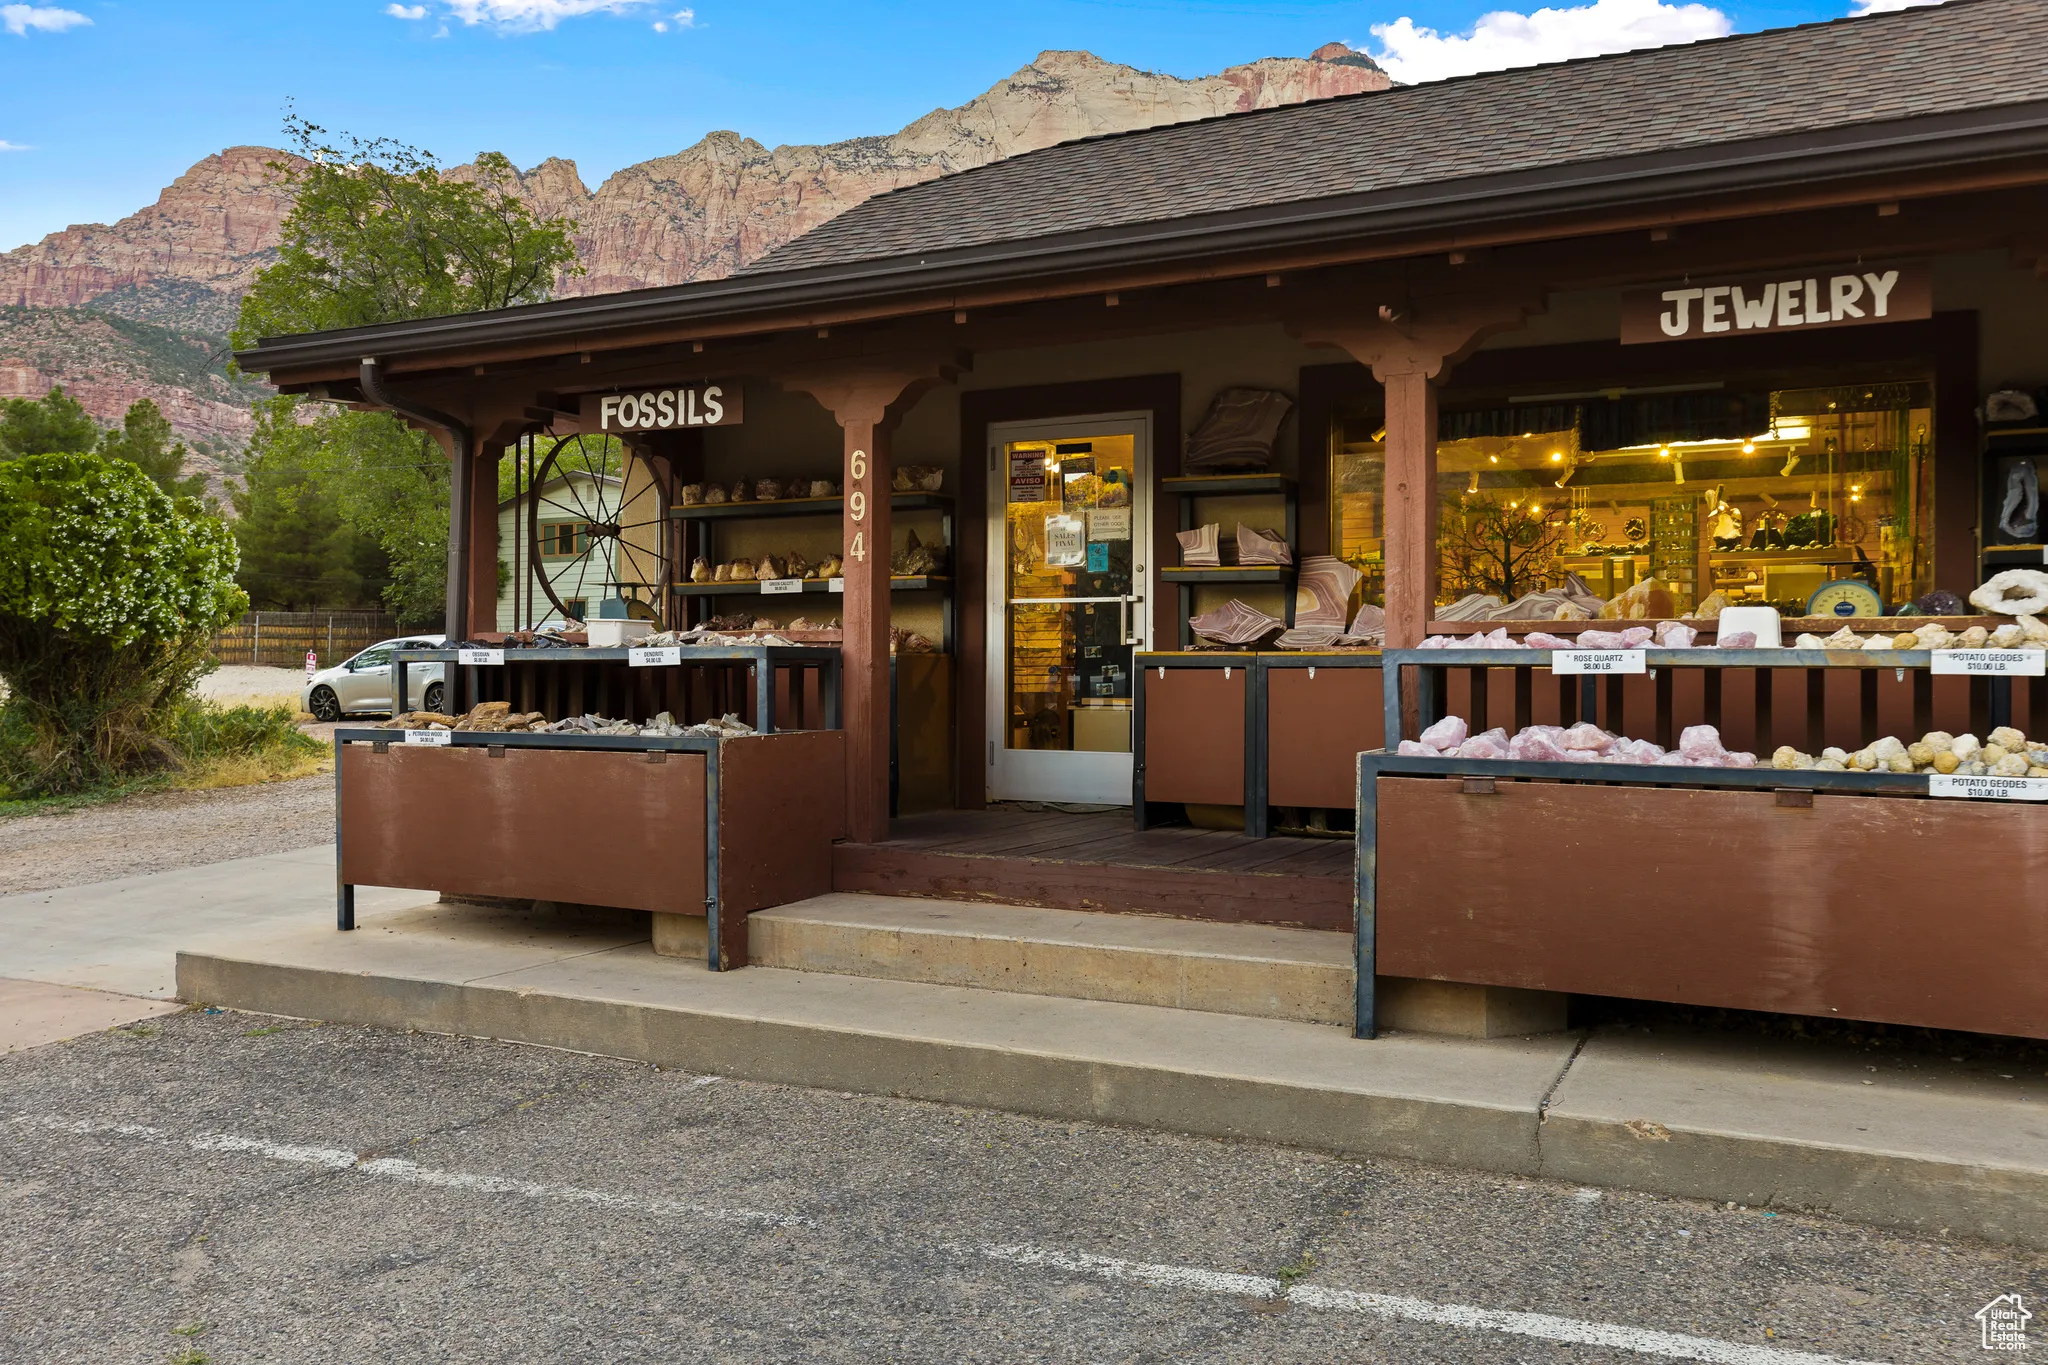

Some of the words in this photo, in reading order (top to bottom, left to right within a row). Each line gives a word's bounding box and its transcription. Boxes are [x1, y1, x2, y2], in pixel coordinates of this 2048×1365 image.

[1660, 270, 1899, 337] JEWELRY
[601, 386, 723, 430] FOSSILS
[850, 449, 866, 562] 694
[1952, 653, 1986, 661] POTATO
[1952, 778, 1987, 787] POTATO
[1990, 779, 2027, 788] GEODES
[1968, 788, 1994, 796] $10.00
